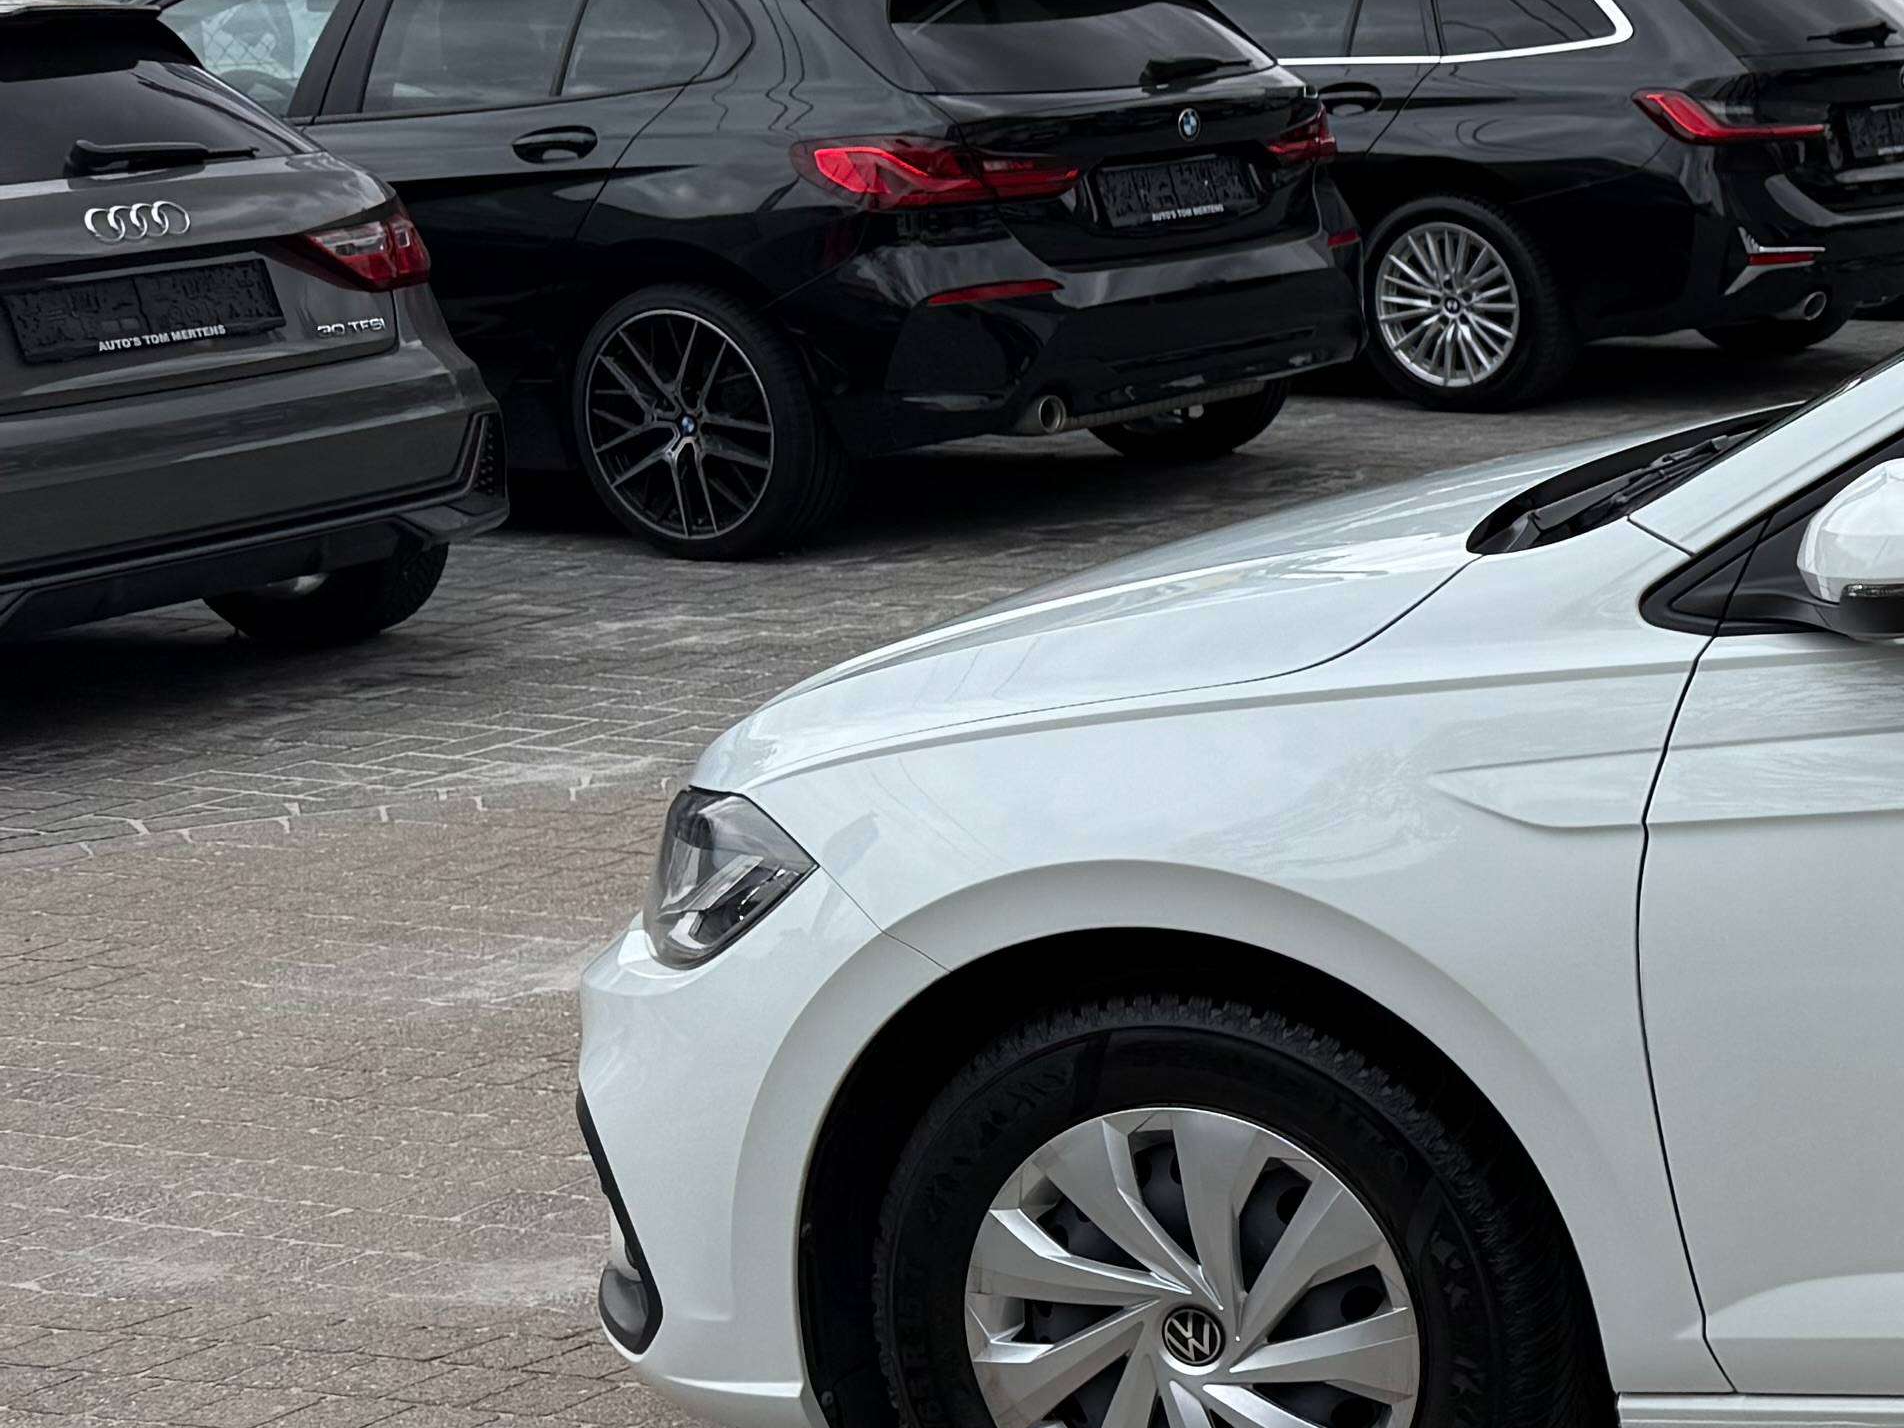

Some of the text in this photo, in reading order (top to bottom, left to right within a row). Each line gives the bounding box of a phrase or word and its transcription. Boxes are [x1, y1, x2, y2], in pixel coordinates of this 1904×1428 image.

[99, 324, 227, 352] AUTO'S TOM MERTENS
